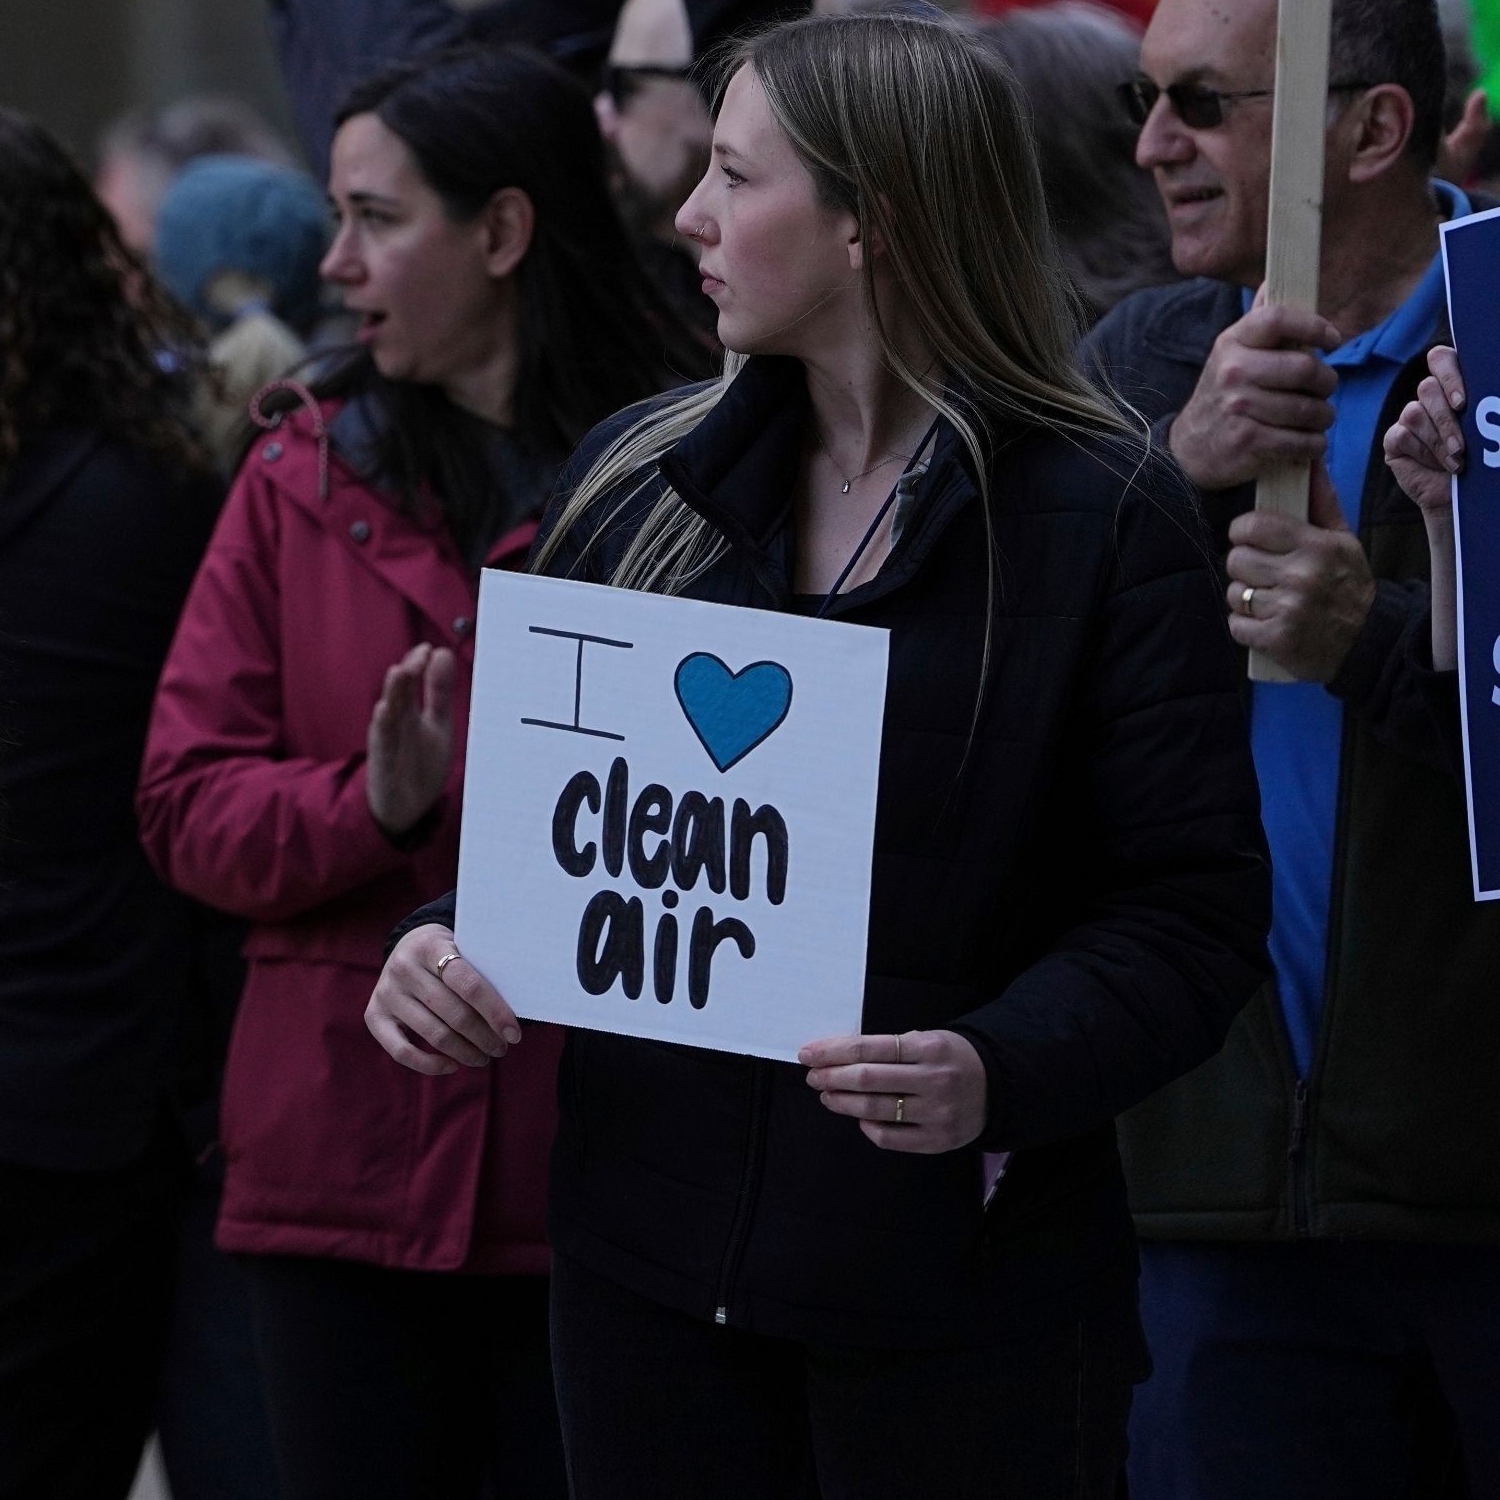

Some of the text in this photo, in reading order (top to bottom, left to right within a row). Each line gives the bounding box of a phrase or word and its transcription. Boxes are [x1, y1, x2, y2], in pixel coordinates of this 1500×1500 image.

[520, 625, 634, 742] I
[551, 756, 789, 906] clean
[576, 889, 756, 1010] air
